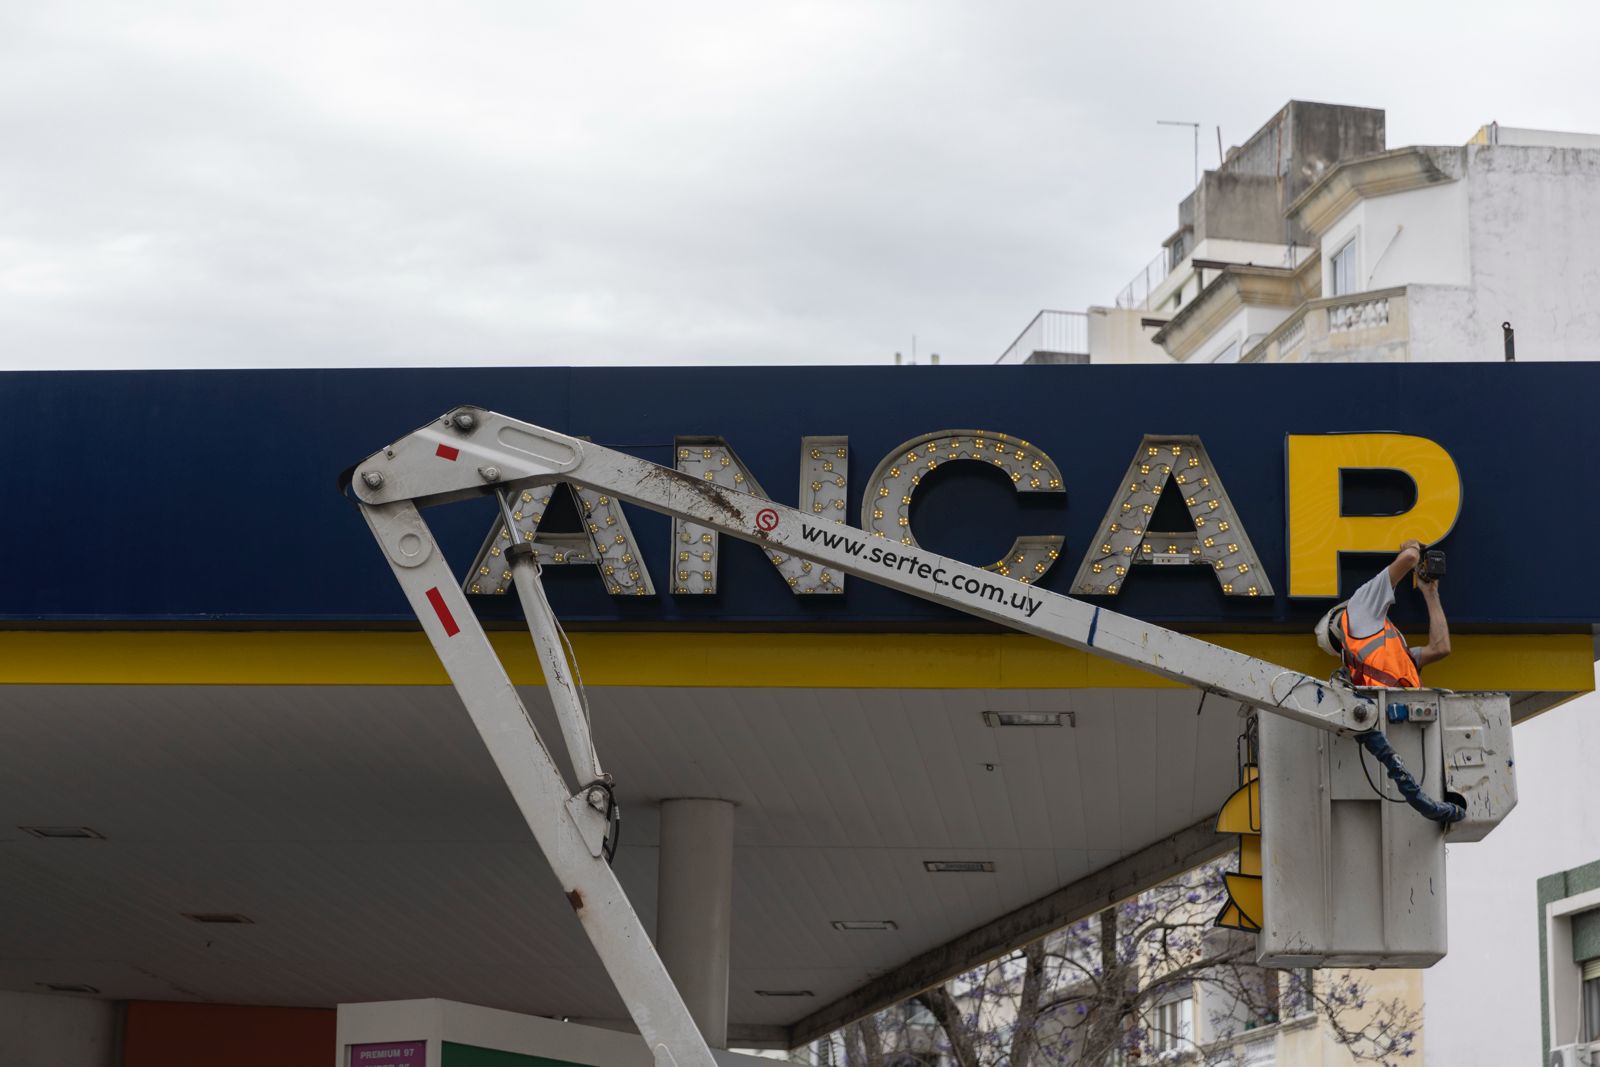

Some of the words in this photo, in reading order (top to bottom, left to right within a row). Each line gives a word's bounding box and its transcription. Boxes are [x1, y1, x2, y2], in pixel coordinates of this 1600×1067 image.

[464, 428, 1463, 598] ANCAP
[801, 524, 1043, 617] www.sertec.com.uy
[360, 1049, 401, 1059] PREMIUM
[403, 1048, 415, 1057] 97
